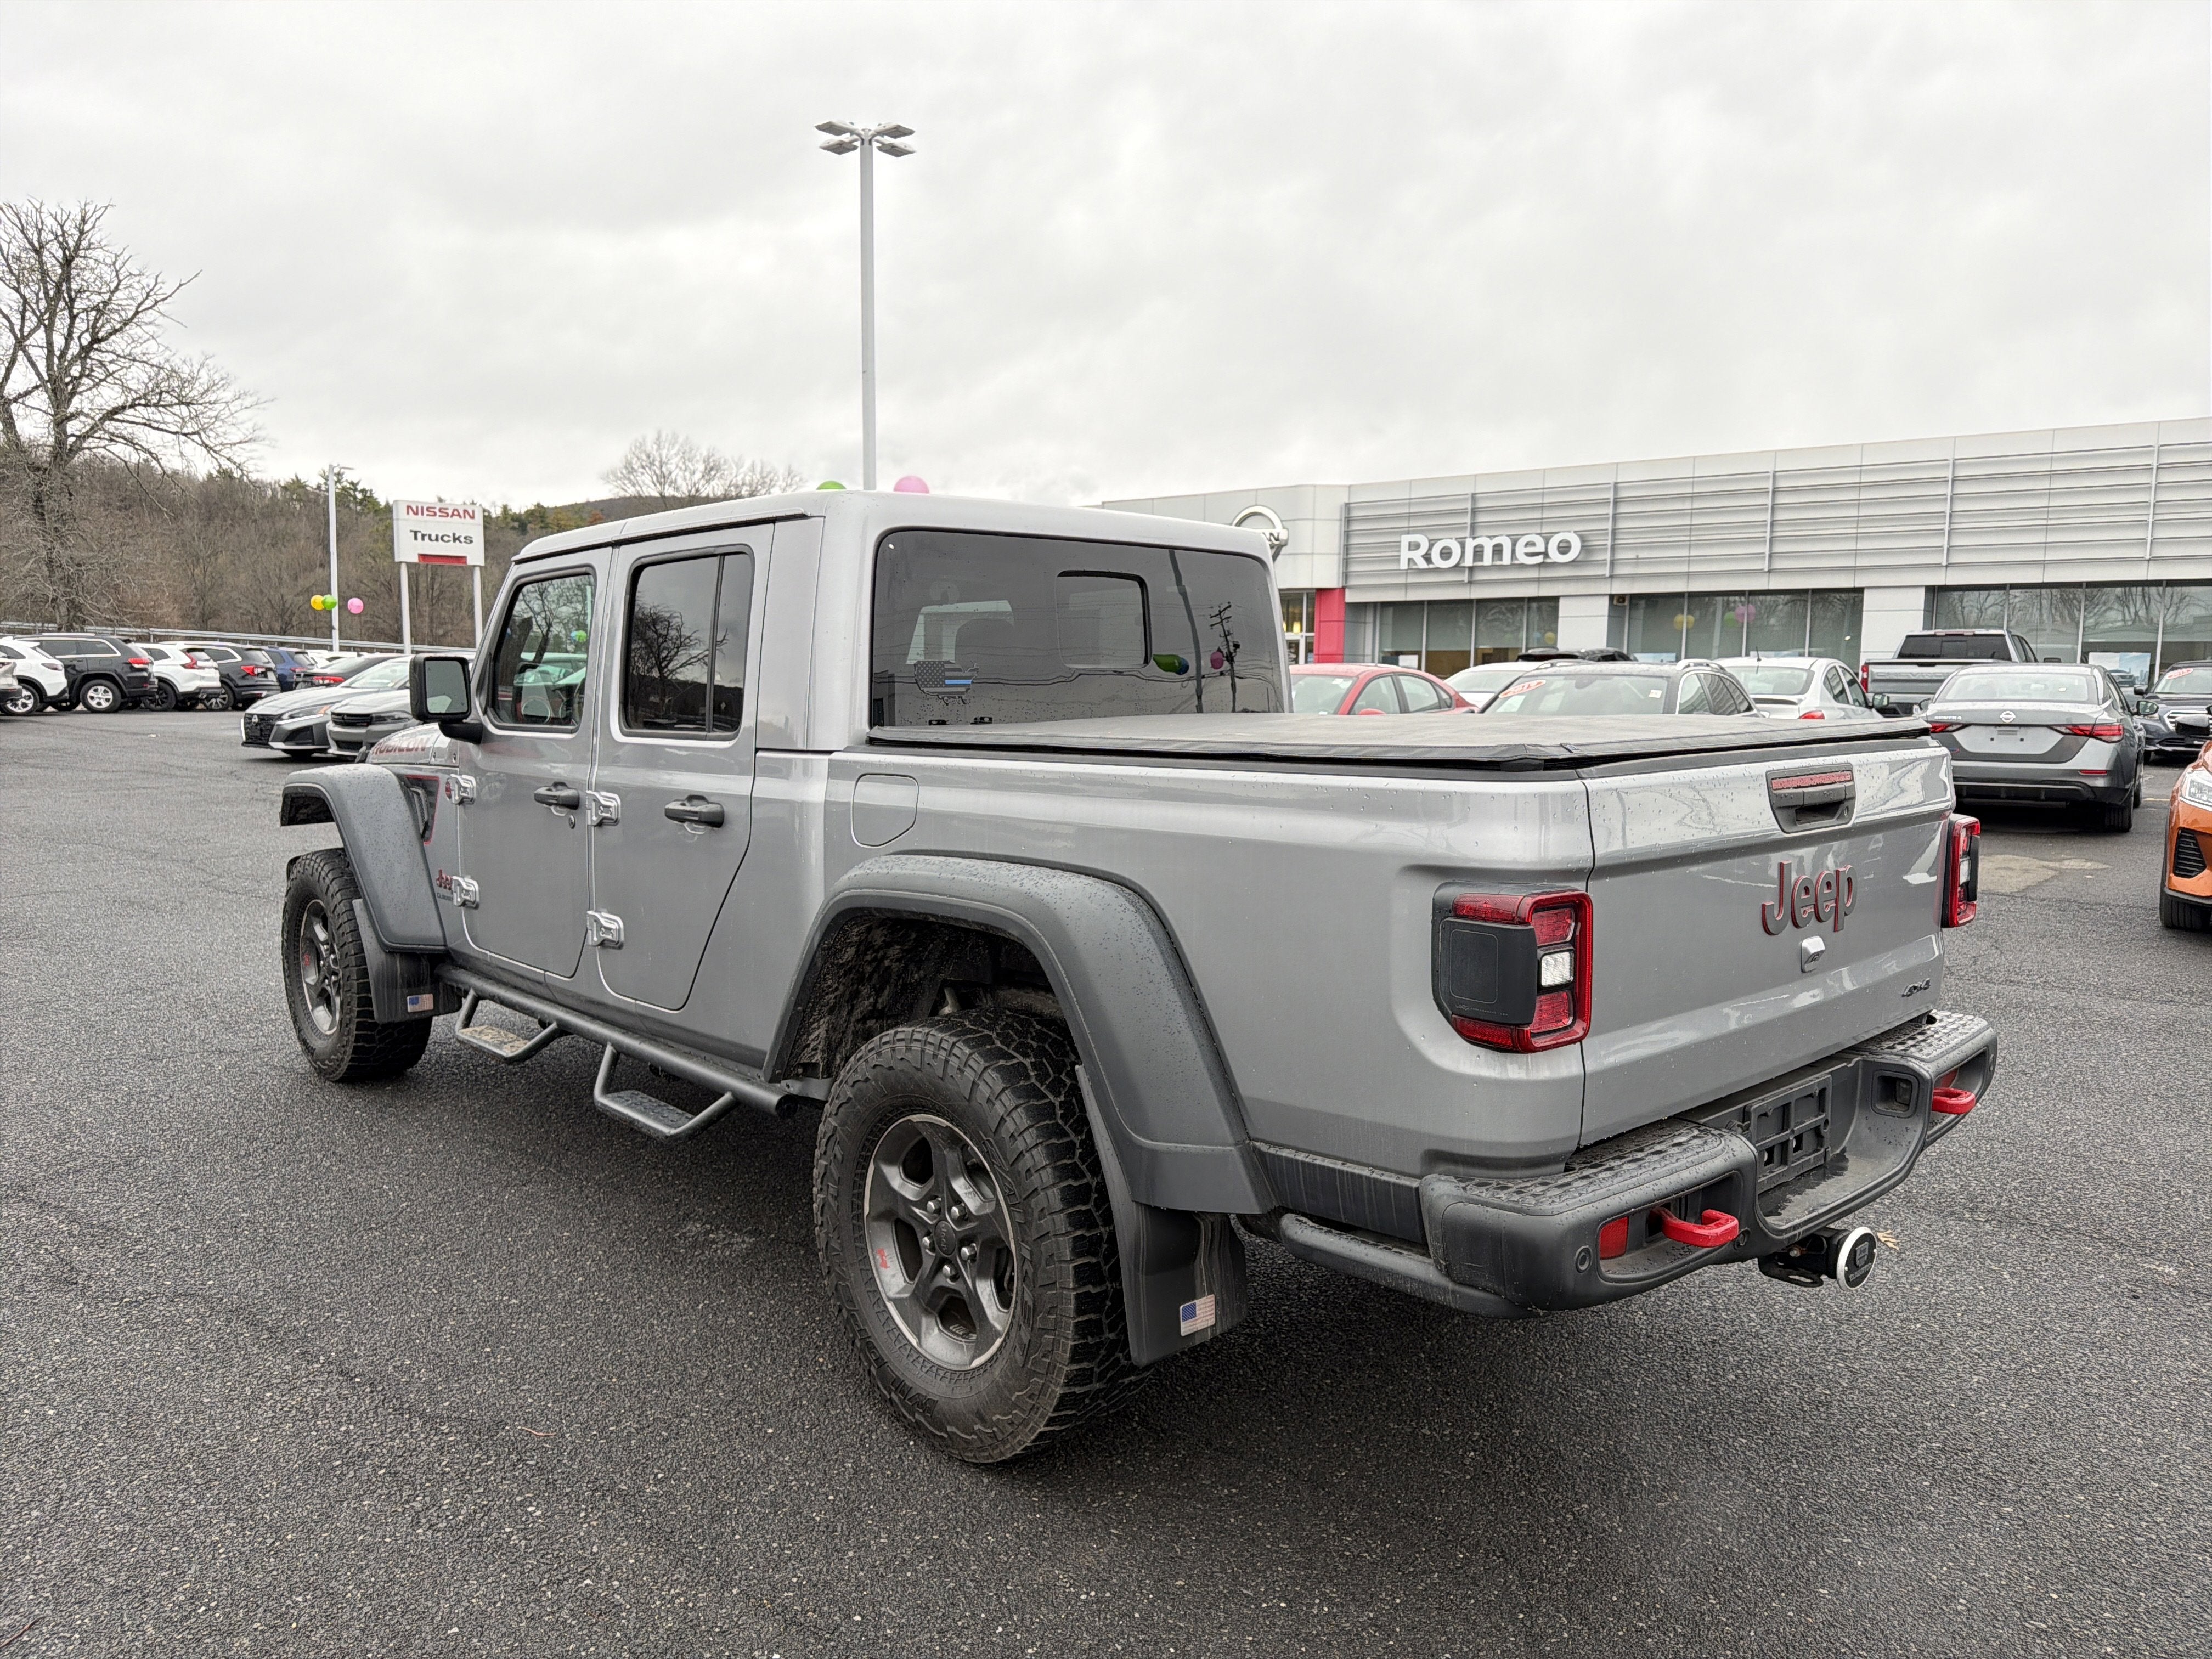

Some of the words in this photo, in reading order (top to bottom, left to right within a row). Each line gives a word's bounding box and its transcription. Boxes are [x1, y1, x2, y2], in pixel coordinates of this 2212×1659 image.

[406, 504, 475, 520] NISSAN
[410, 529, 474, 544] Trucks
[1400, 531, 1581, 569] Romeo
[1762, 860, 1858, 936] Jeep
